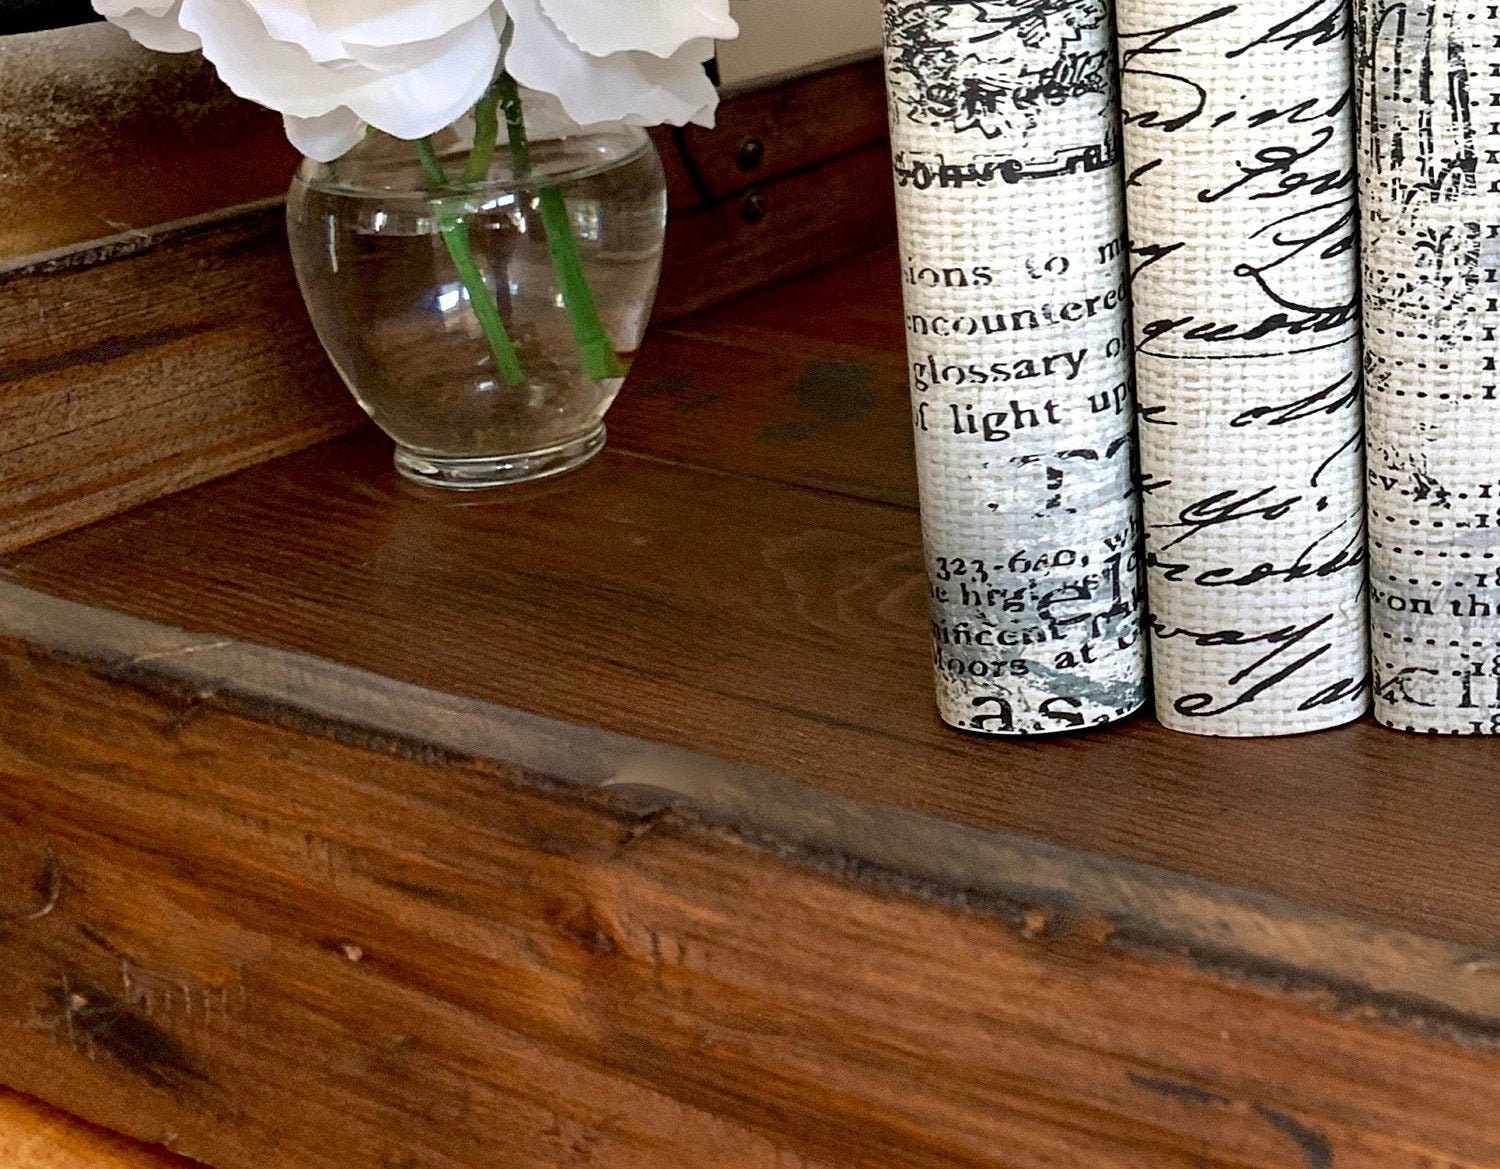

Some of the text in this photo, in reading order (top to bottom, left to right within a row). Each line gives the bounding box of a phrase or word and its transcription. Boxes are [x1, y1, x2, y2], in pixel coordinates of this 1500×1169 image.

[913, 348, 1089, 392] glossary
[950, 399, 1063, 442] light
[1055, 642, 1098, 670] at
